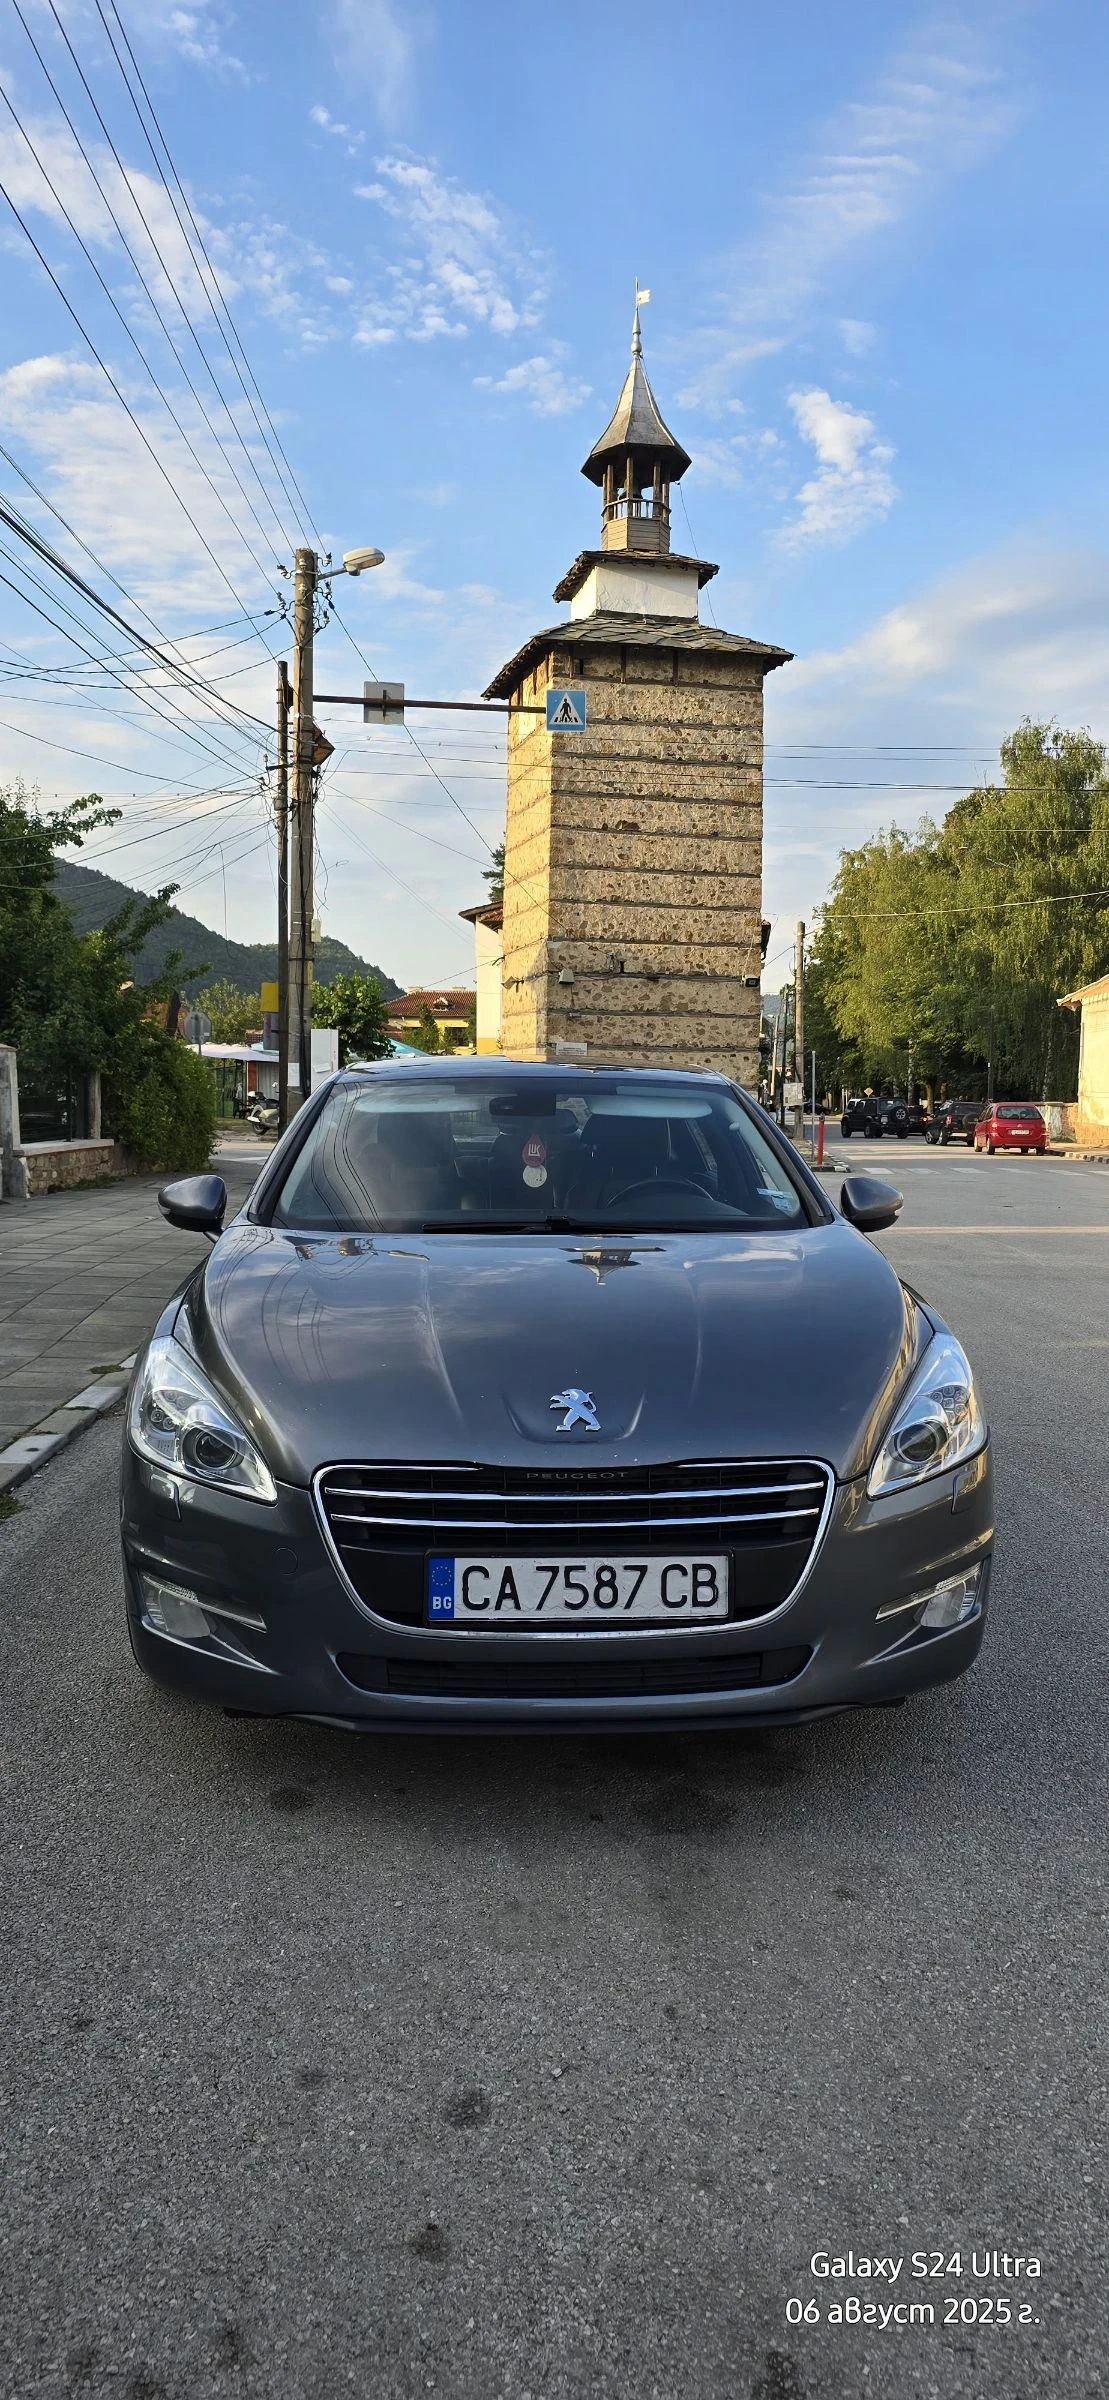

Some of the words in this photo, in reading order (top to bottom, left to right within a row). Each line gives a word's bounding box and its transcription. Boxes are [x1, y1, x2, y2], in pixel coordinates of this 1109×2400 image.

[526, 1472, 629, 1480] PEUGEOT
[462, 1565, 521, 1611] CA
[535, 1564, 648, 1611] 7587
[660, 1563, 719, 1609] CB
[432, 1596, 452, 1610] BG
